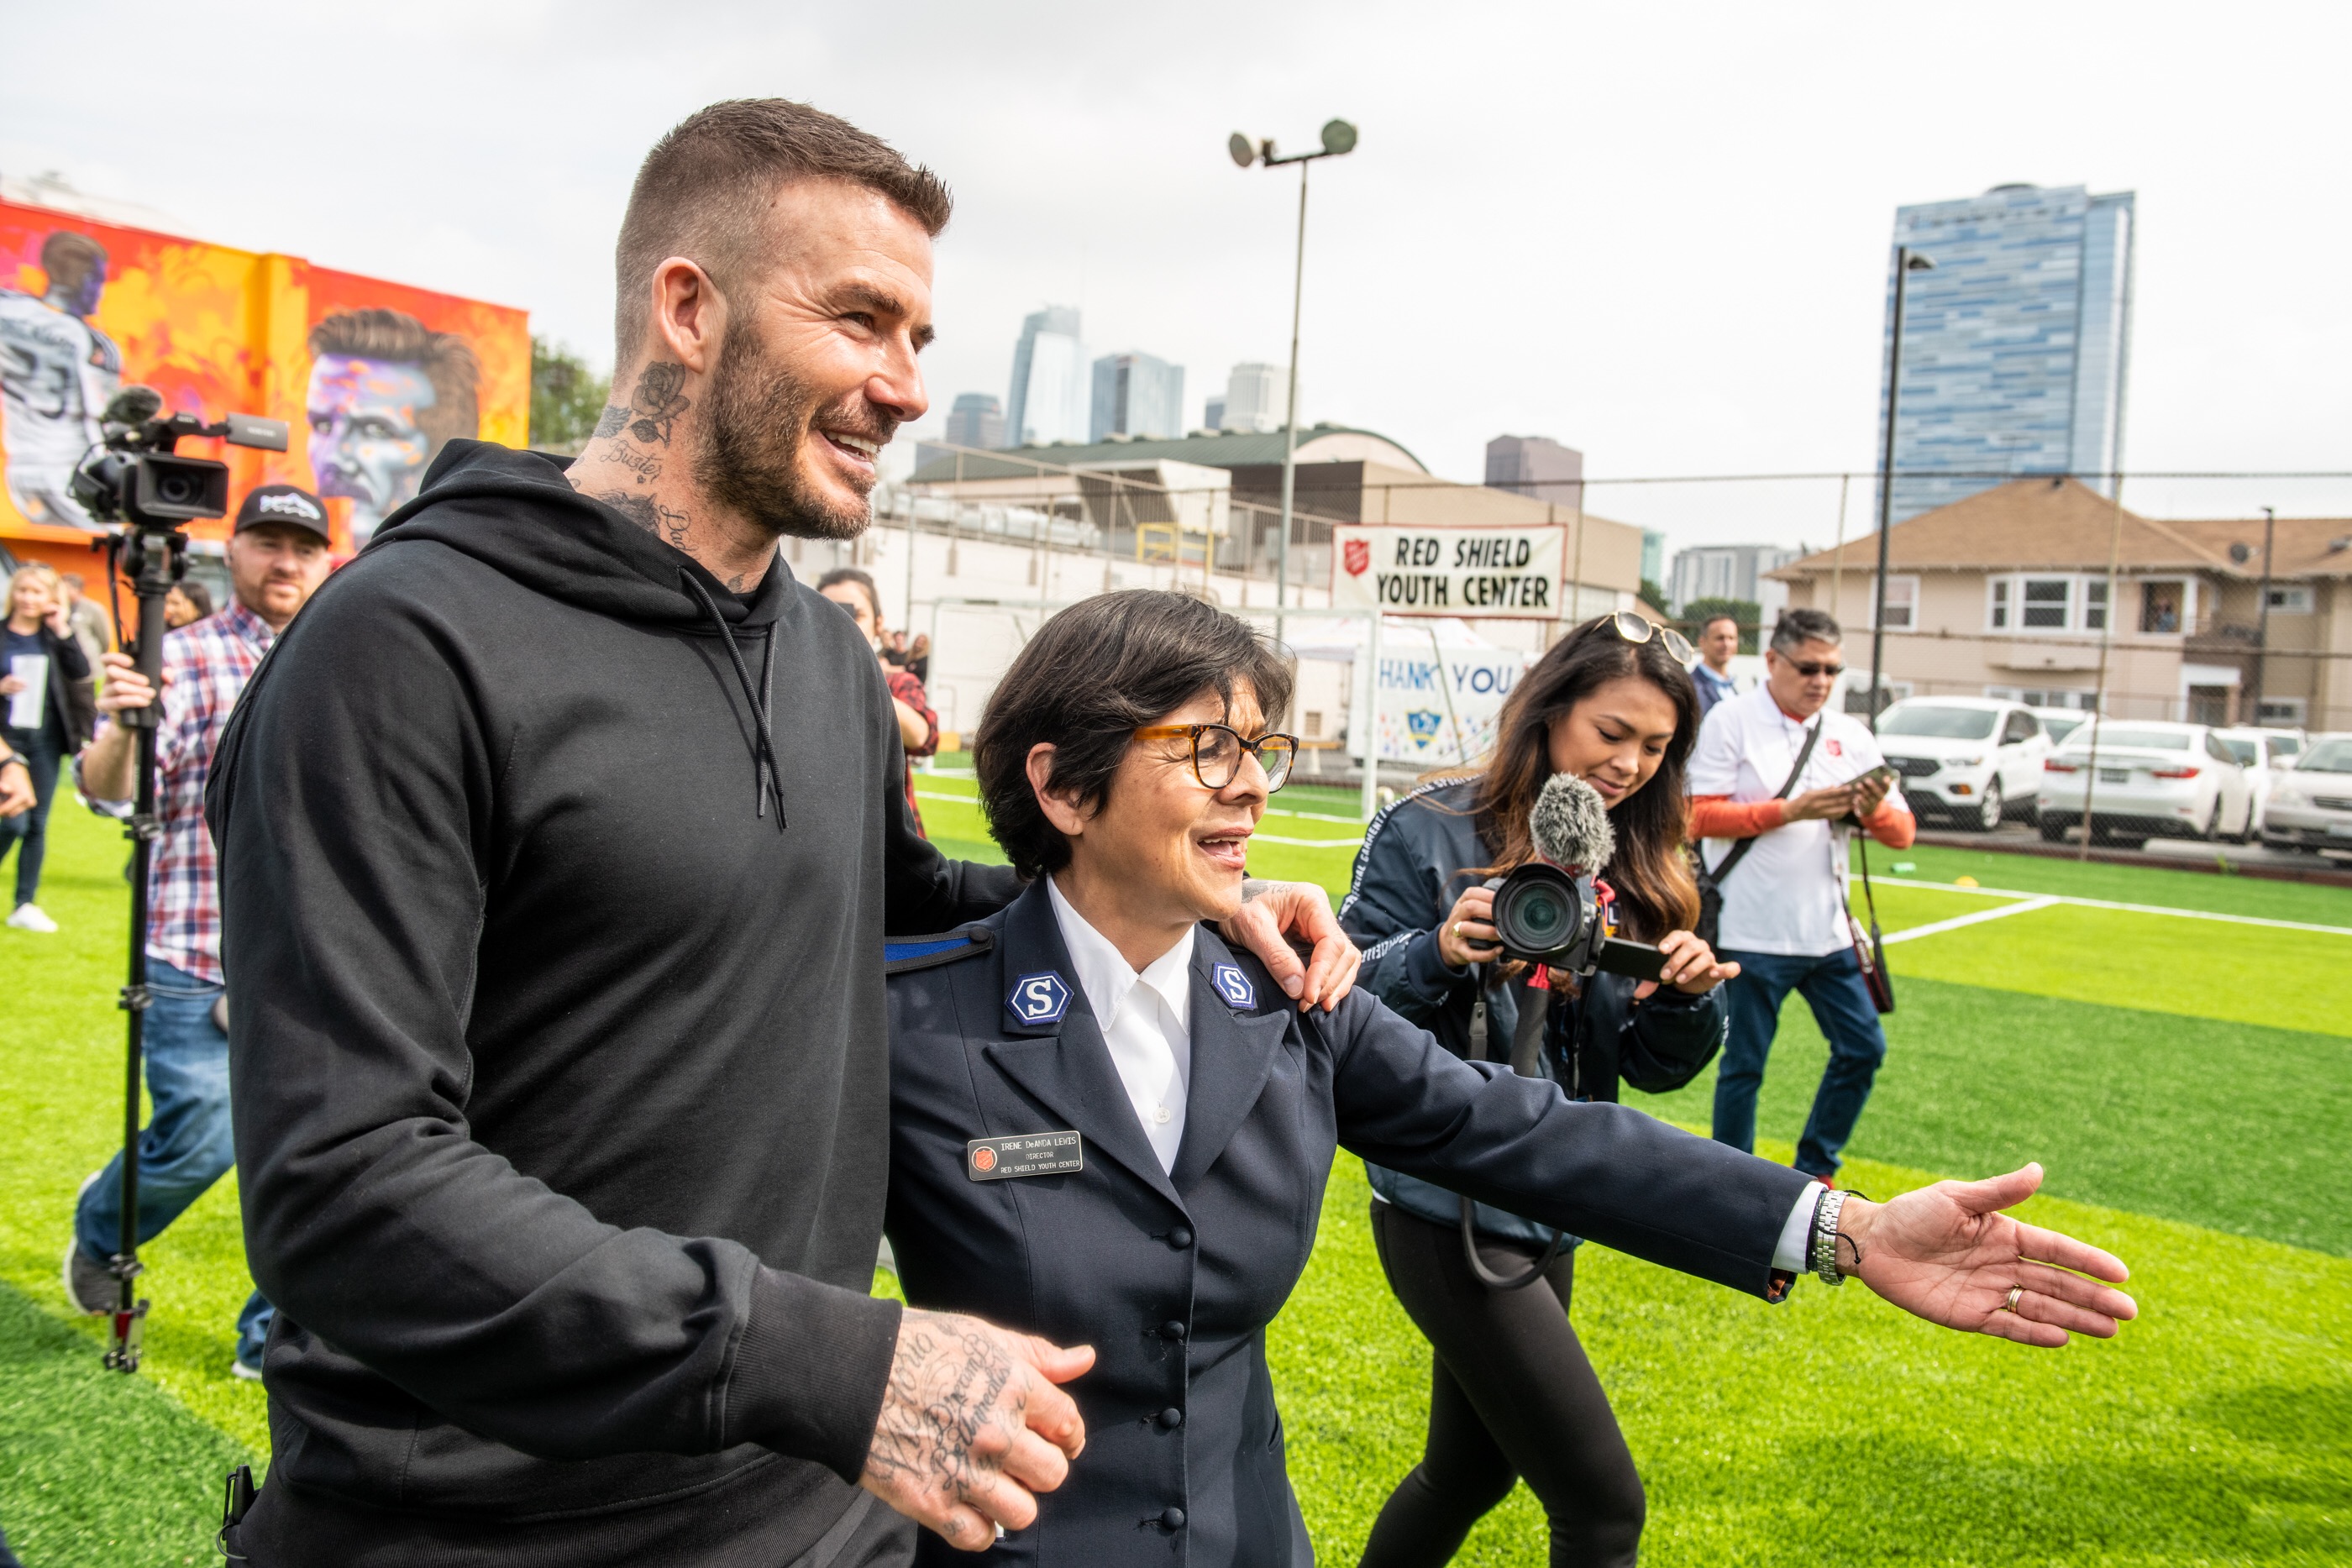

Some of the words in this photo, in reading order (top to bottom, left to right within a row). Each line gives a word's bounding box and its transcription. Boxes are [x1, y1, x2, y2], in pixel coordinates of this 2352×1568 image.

[600, 438, 663, 484] Buster
[1395, 538, 1440, 567] RED
[1455, 538, 1530, 568] SHIELD
[1378, 575, 1449, 606] YOUTH
[1464, 577, 1549, 606] CENTER
[1379, 658, 1441, 692] HANK
[1452, 662, 1513, 695] YOU
[1360, 817, 1384, 863] GARMENT
[1026, 979, 1053, 1016] S
[1224, 970, 1247, 1000] S
[1000, 1141, 1022, 1151] IRENE
[1026, 1139, 1052, 1149] DeANDA
[1054, 1136, 1077, 1146] LEWIS
[1026, 1151, 1054, 1161] DIRECTOR
[1000, 1166, 1012, 1174] RED
[1014, 1165, 1036, 1173] SHIELD
[1058, 1160, 1080, 1168] CENTER
